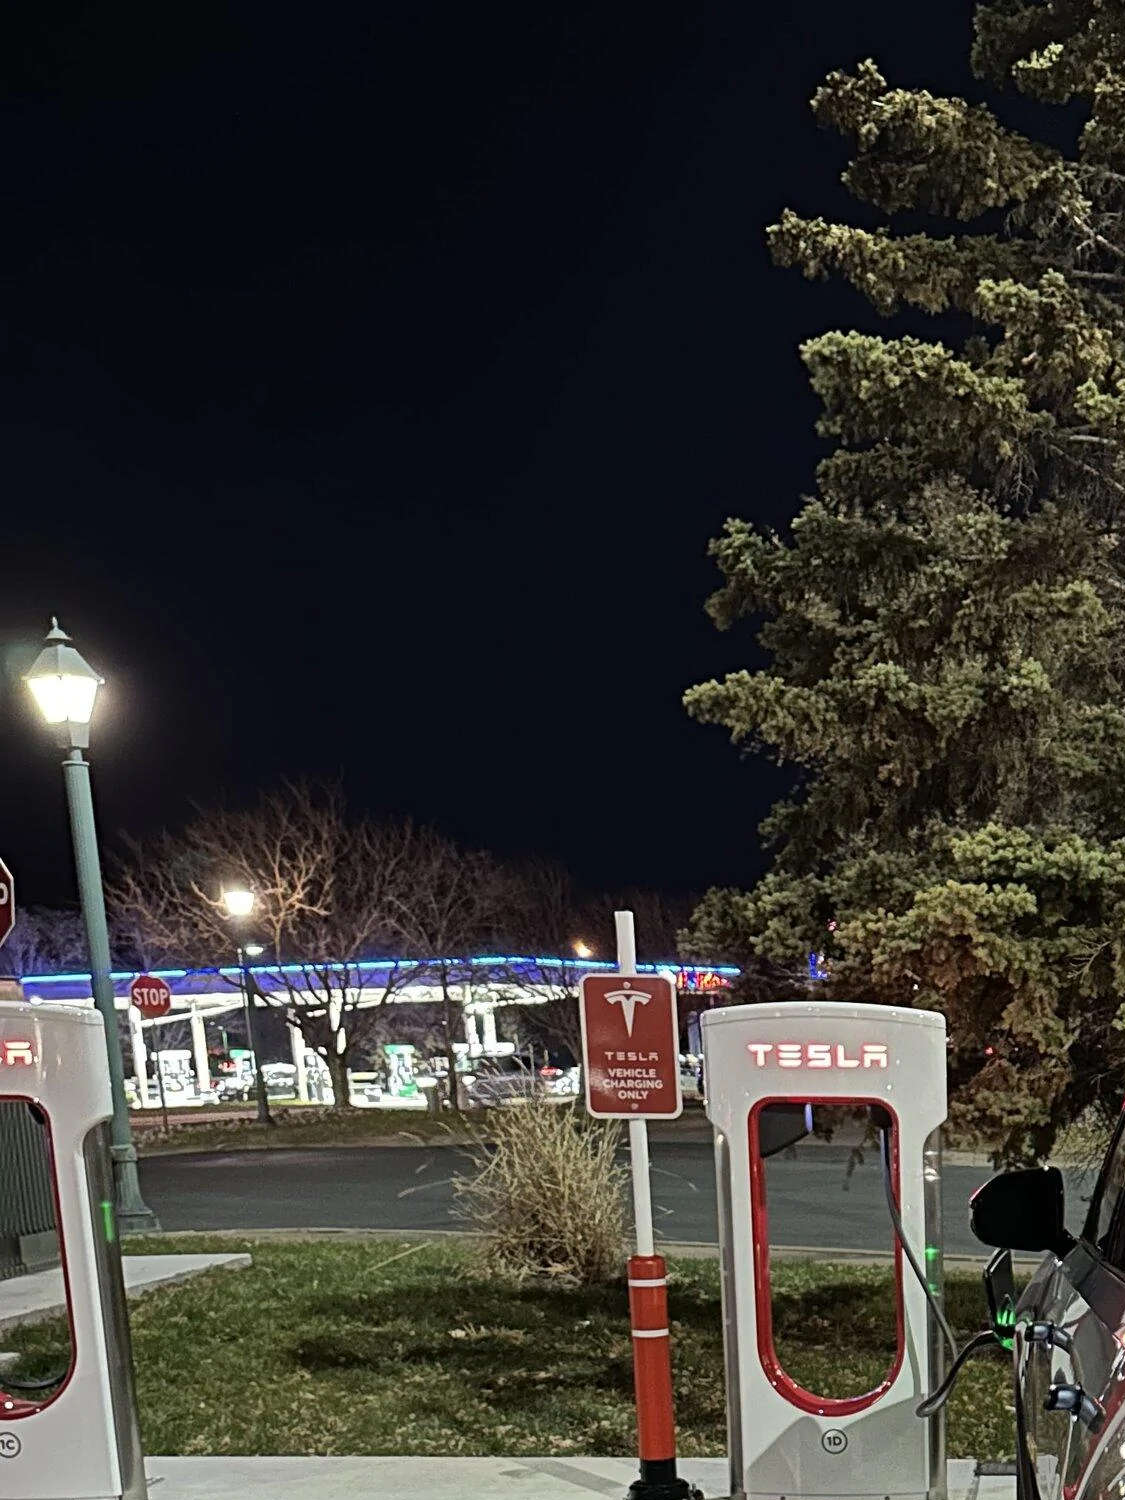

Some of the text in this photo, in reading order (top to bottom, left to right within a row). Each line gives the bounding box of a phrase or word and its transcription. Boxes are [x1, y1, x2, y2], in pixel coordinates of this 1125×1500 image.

[132, 987, 168, 1006] STOP
[604, 1051, 659, 1061] TESLA
[747, 1043, 888, 1069] TESLA
[608, 1068, 657, 1078] VEHICLE
[602, 1079, 663, 1090] CHARGING
[618, 1090, 649, 1100] ONLY
[826, 1436, 842, 1446] 1D
